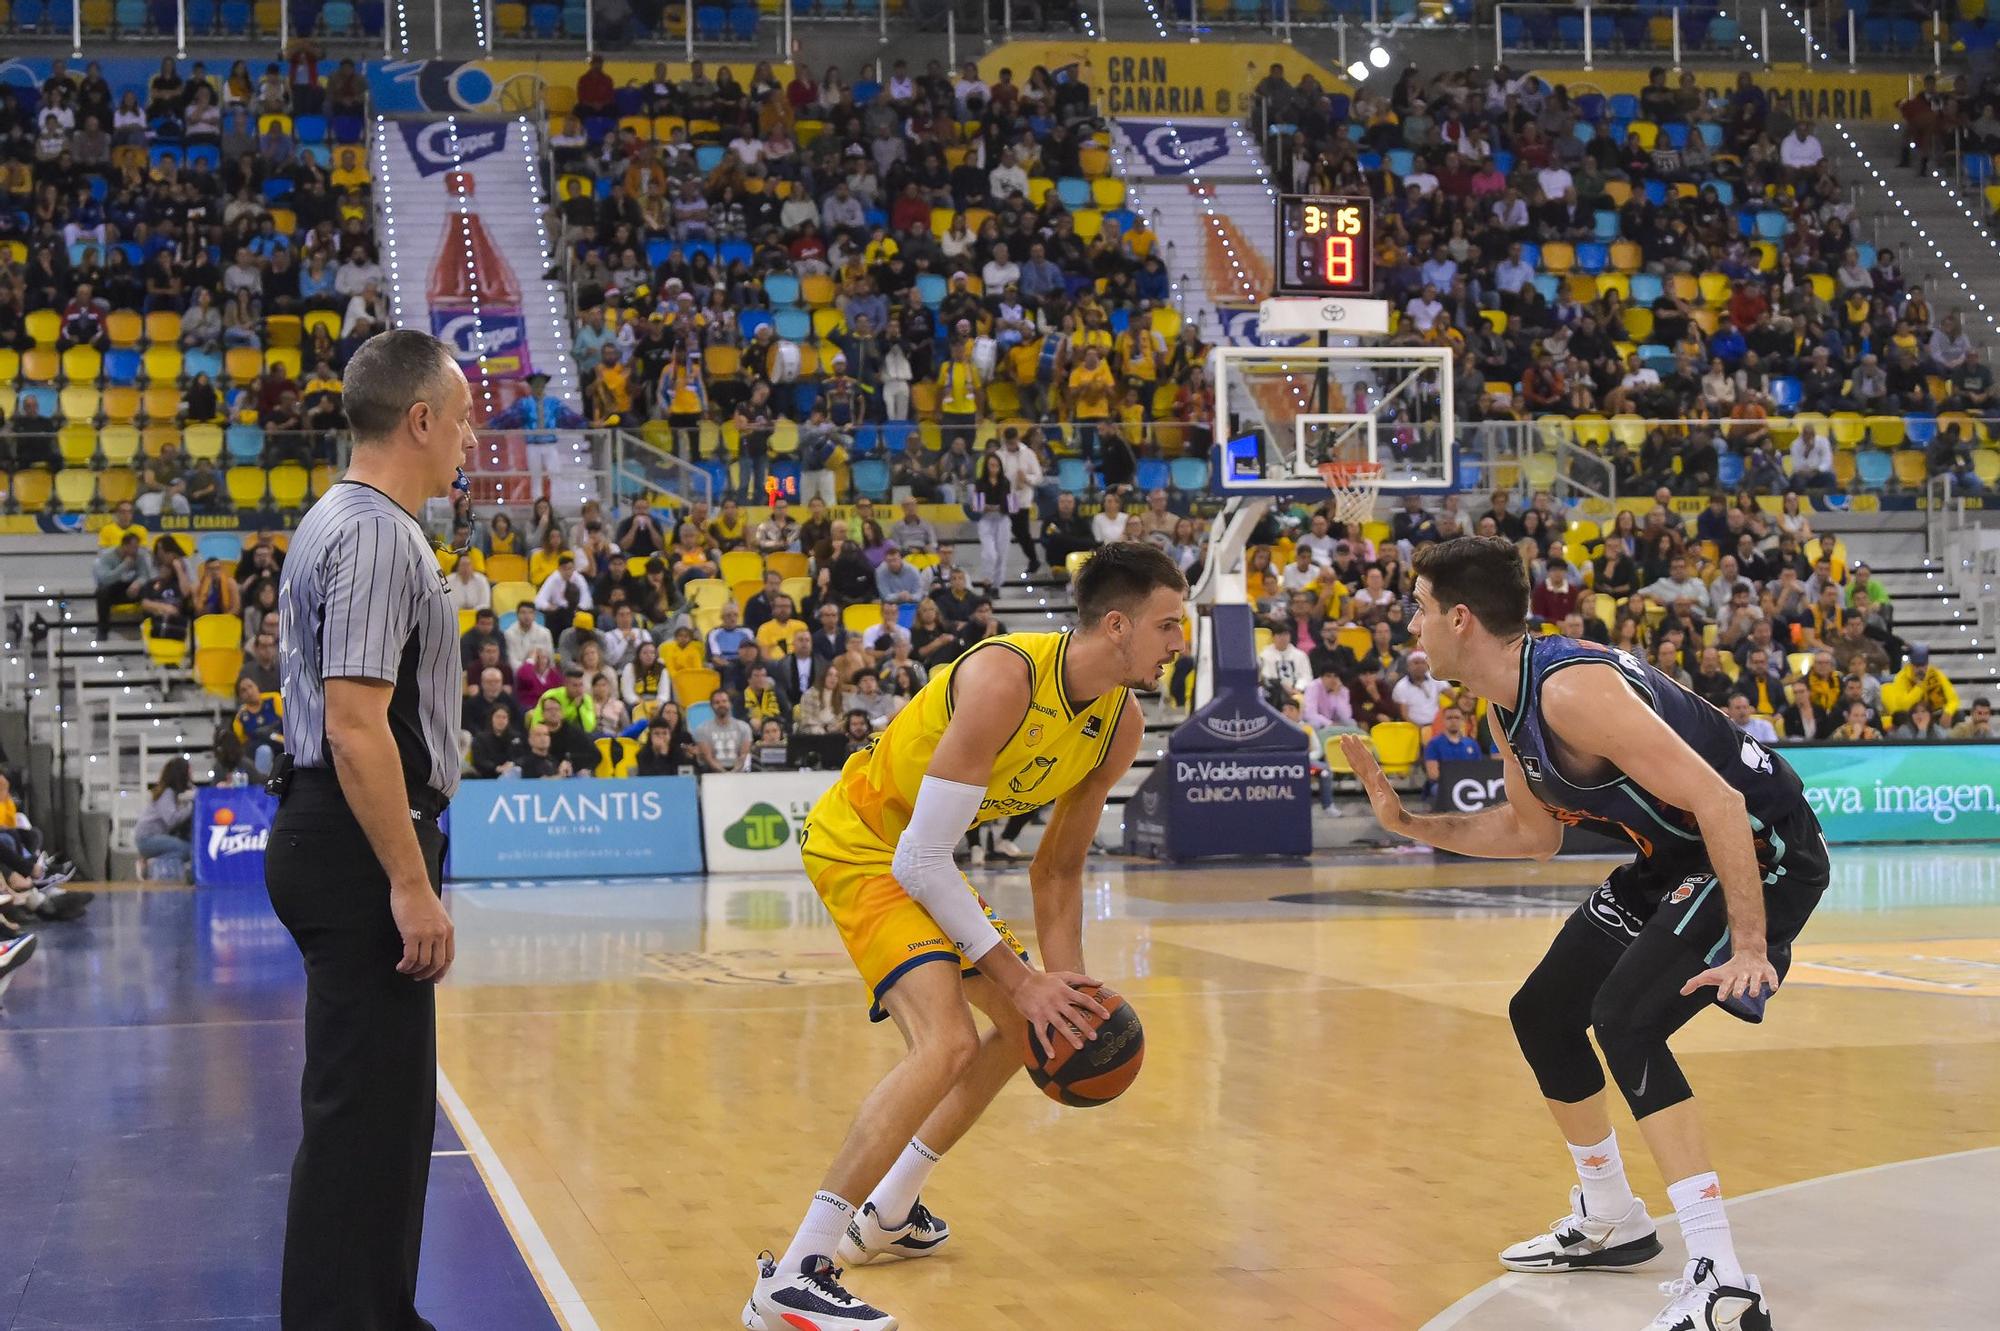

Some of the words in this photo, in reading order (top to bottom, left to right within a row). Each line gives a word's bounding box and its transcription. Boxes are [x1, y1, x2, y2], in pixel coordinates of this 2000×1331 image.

[1108, 56, 1166, 83] GRAN
[1108, 85, 1204, 113] CANARIA
[1304, 205, 1361, 235] 3:15
[1326, 236, 1353, 284] 8
[1246, 784, 1296, 801] DENTAL
[487, 791, 663, 824] ATLANTIS
[907, 938, 945, 952] SPALDING
